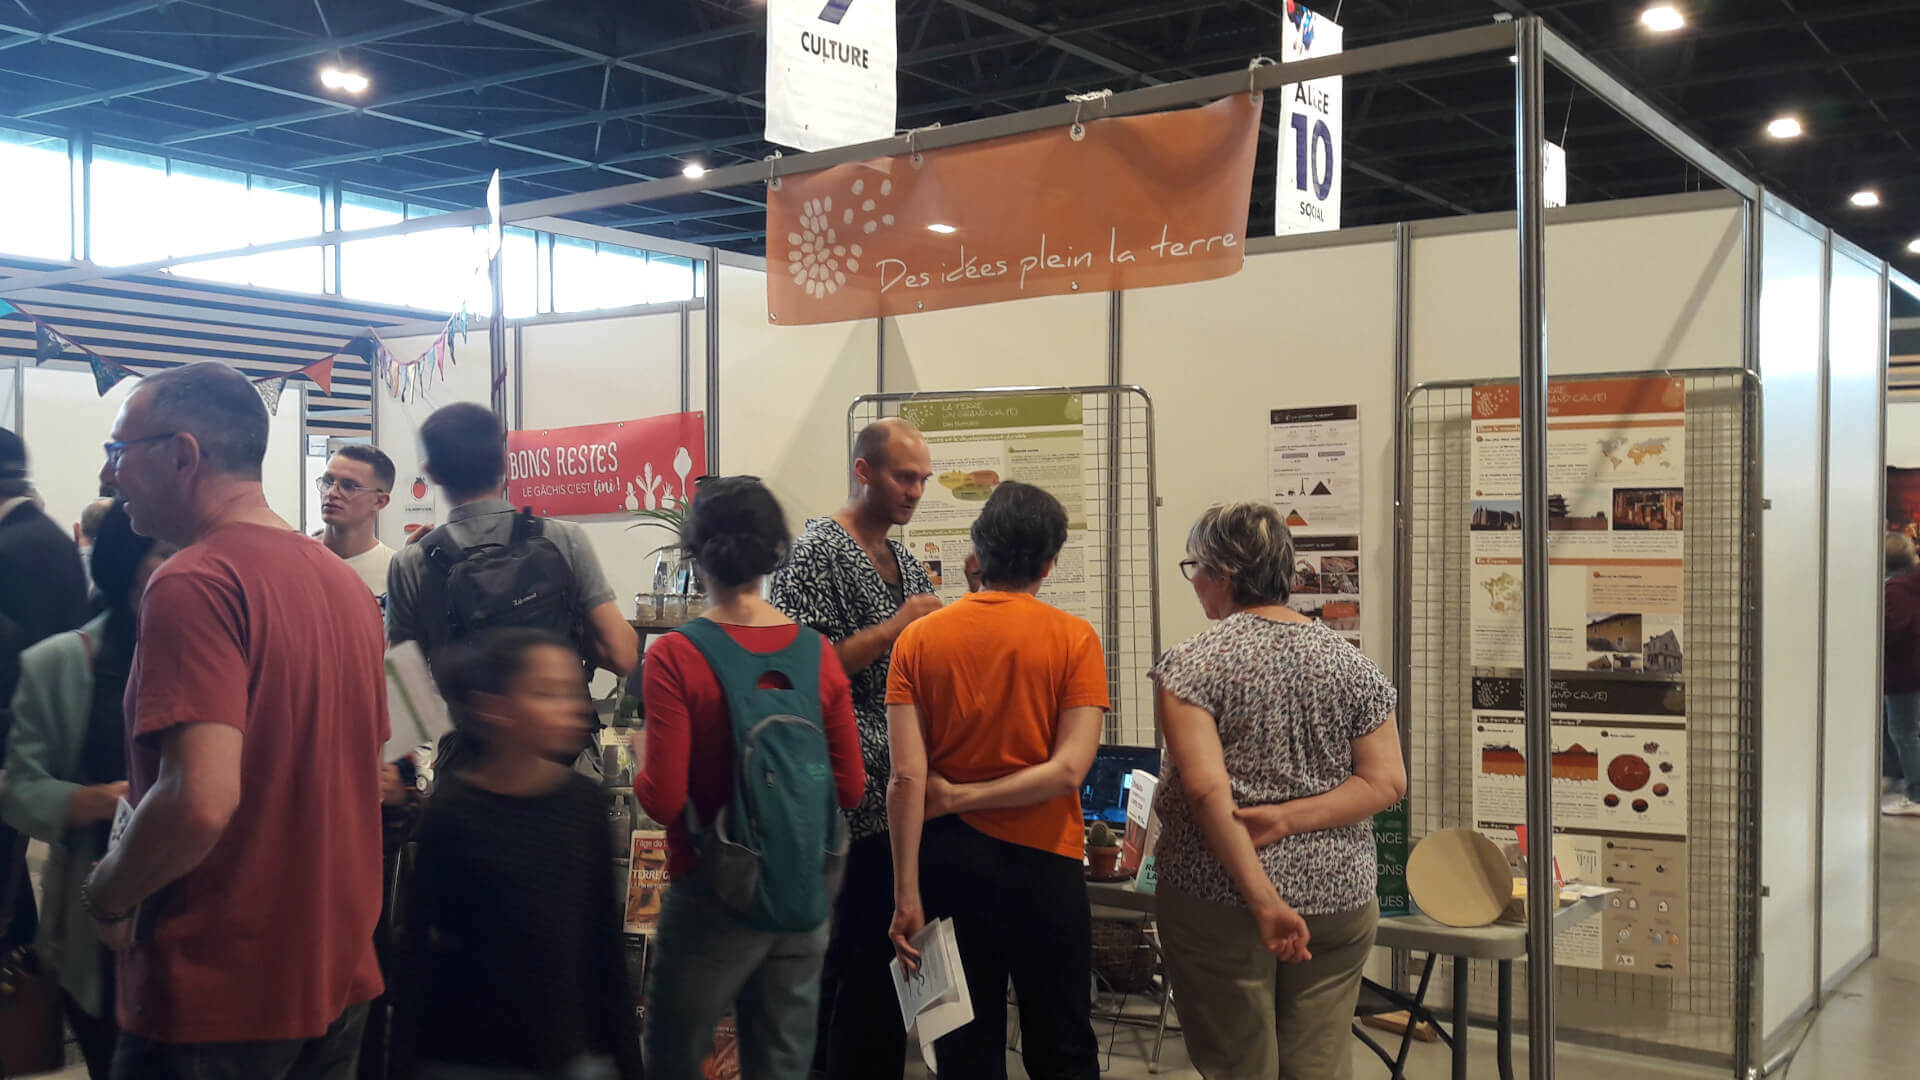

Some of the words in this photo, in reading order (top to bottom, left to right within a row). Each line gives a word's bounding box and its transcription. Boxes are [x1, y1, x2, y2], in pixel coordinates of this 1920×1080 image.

[801, 31, 869, 70] CULTURE
[1291, 112, 1334, 201] 10
[1300, 201, 1325, 223] SOCIAL
[875, 258, 931, 294] Des
[941, 244, 1008, 283] idées
[1020, 232, 1093, 290] plein
[1110, 226, 1136, 264] la
[1151, 223, 1238, 258] terre
[508, 447, 551, 481] BONS
[556, 441, 619, 476] RESTES
[522, 486, 533, 497] LE
[534, 483, 566, 497] GÂCHIS
[567, 482, 591, 495] C'EST
